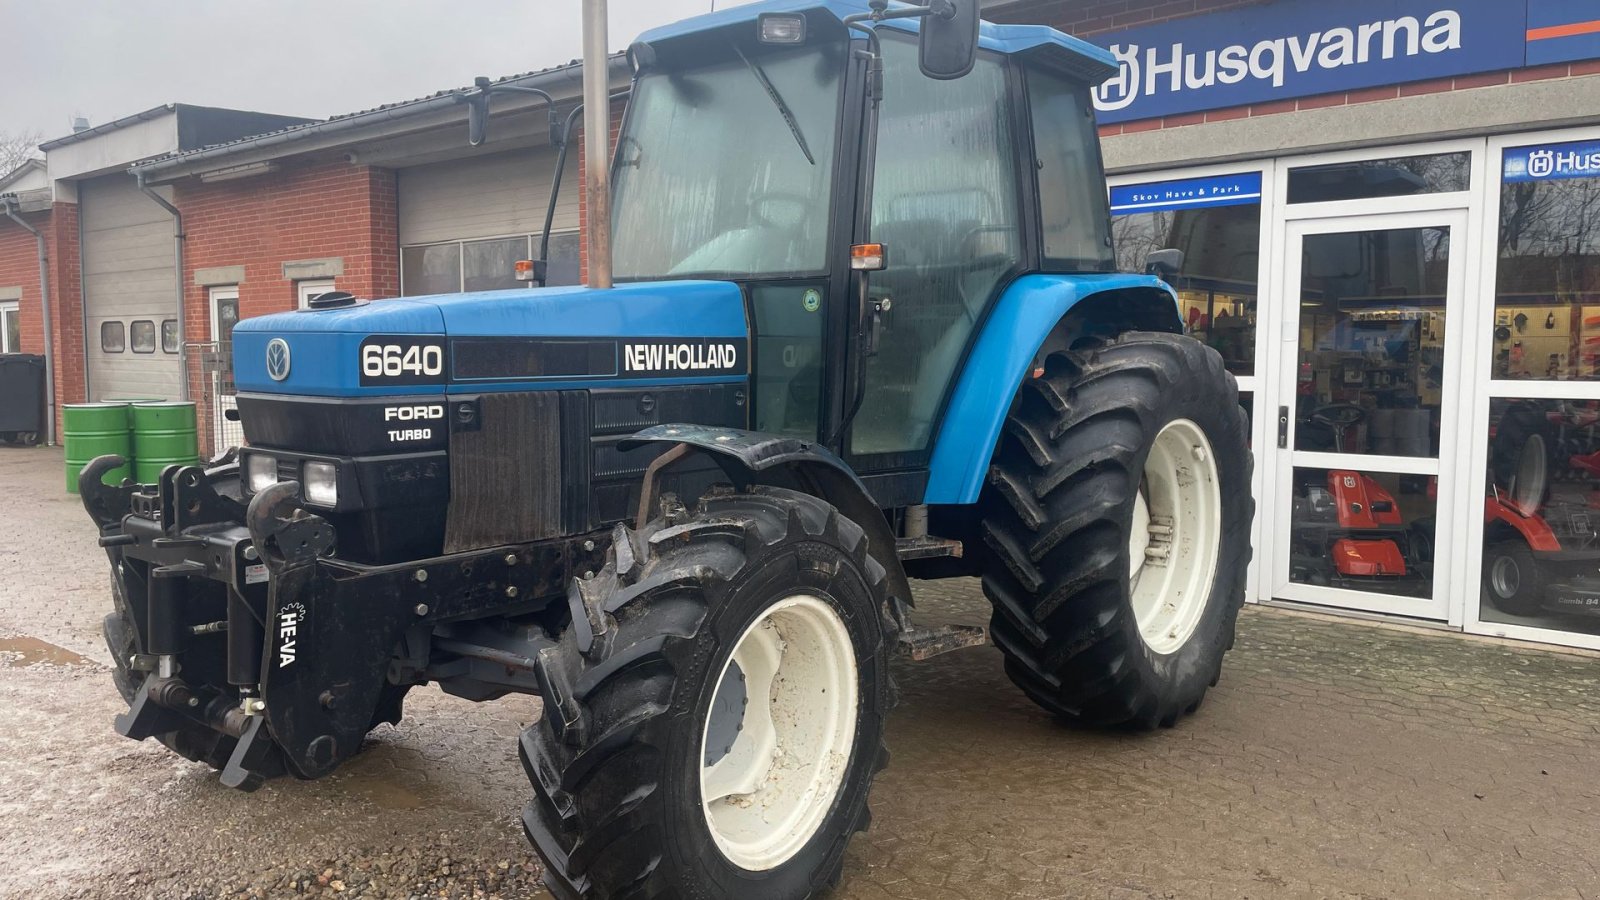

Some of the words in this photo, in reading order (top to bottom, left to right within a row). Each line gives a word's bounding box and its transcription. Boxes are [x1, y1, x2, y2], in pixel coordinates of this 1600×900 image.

[1145, 9, 1461, 96] Husqvarna
[1132, 193, 1159, 202] Skov
[1165, 190, 1194, 199] Have
[1198, 188, 1205, 196] &
[1212, 184, 1240, 194] Park
[362, 344, 443, 377] 6640
[624, 344, 663, 371] NEW
[665, 343, 737, 370] HOLLAND
[384, 405, 444, 421] FORD
[387, 428, 432, 442] TURBO
[279, 612, 297, 668] HE-VA
